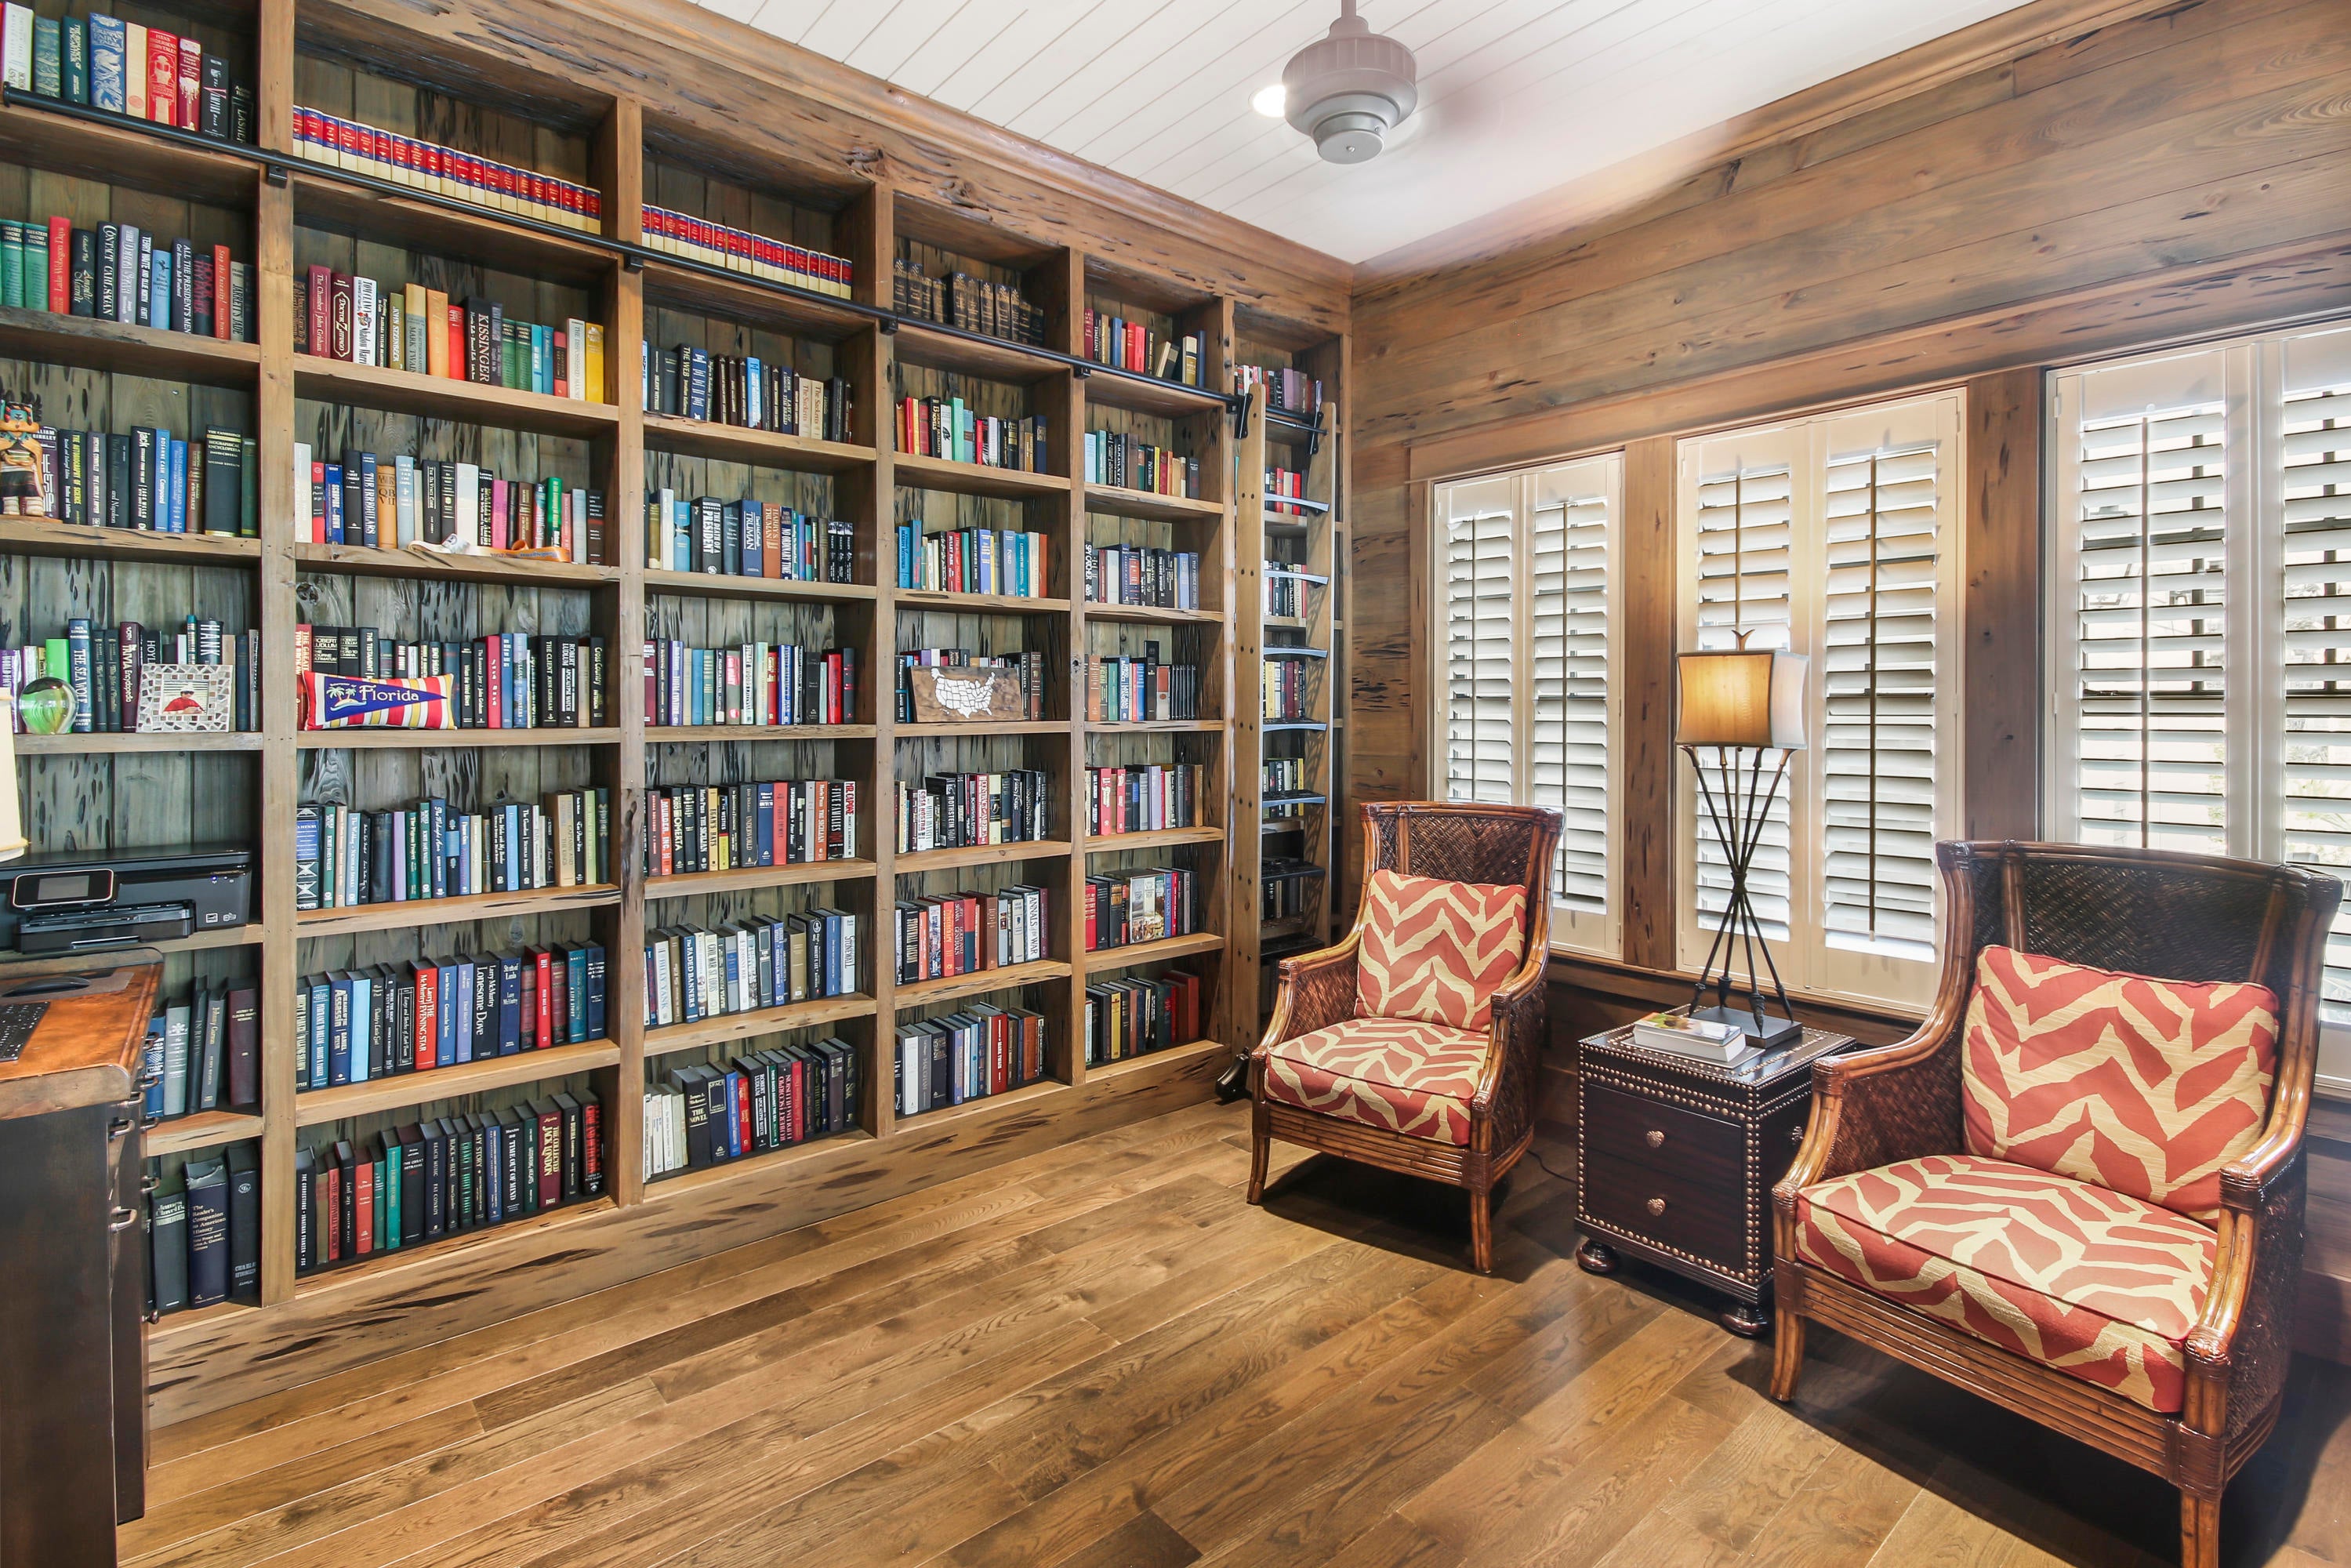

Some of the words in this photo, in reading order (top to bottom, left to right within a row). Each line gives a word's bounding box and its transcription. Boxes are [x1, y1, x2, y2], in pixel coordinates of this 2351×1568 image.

[103, 225, 117, 261] CONTACT
[103, 266, 114, 288] CARL
[194, 260, 204, 278] THY
[204, 263, 213, 299] HONOR
[103, 288, 114, 315] SAGAN
[194, 279, 204, 314] FATHER
[232, 284, 243, 318] JARRETT'S
[232, 318, 243, 336] JADE
[315, 314, 324, 328] John
[336, 321, 348, 351] ZHIVAGO
[477, 313, 490, 382] KISSINGER
[72, 434, 81, 443] THE
[136, 430, 151, 448] jack
[72, 443, 81, 479] AUTOBIOGRAPHY
[158, 478, 167, 504] Composed
[365, 473, 375, 488] THE
[72, 487, 81, 505] SCIENCE
[111, 501, 119, 524] Napoleon
[365, 488, 376, 535] IRREGULARS
[702, 510, 714, 554] PRESIDENT
[746, 511, 754, 550] TRUMAN
[782, 535, 792, 561] ORDINARY
[782, 561, 792, 575] TIME
[200, 624, 220, 655] HANK
[74, 648, 86, 666] THE
[122, 644, 133, 670] TRIVIA
[594, 647, 603, 662] Cross
[74, 666, 86, 682] SEA
[593, 662, 603, 685] Country
[76, 682, 87, 703] WOLF
[123, 670, 133, 702] Encyclopedia
[359, 684, 419, 702] Florida
[832, 788, 841, 802] FIVE
[845, 793, 854, 815] CAPONE
[832, 803, 841, 832] FAMILIES
[673, 817, 683, 851] OMERTA
[1029, 896, 1039, 927] ANNALS
[707, 943, 717, 957] CIVIL
[844, 935, 855, 969] STONEWALL
[1030, 937, 1039, 955] WAR
[488, 965, 496, 979] Larry
[707, 957, 717, 969] WAR
[707, 969, 717, 978] ST.
[419, 974, 427, 1004] McMurtry
[426, 987, 434, 1003] Larry
[476, 967, 488, 1011] Lonesome
[488, 980, 496, 1007] McMurtry
[707, 978, 717, 993] LOUIS
[334, 989, 346, 1027] Assassin
[476, 1012, 487, 1036] Dove
[690, 1114, 707, 1123] NOVEL
[475, 1134, 482, 1145] MY
[542, 1126, 552, 1146] JACK
[541, 1145, 553, 1176] LONDON
[510, 1173, 516, 1182] OF
